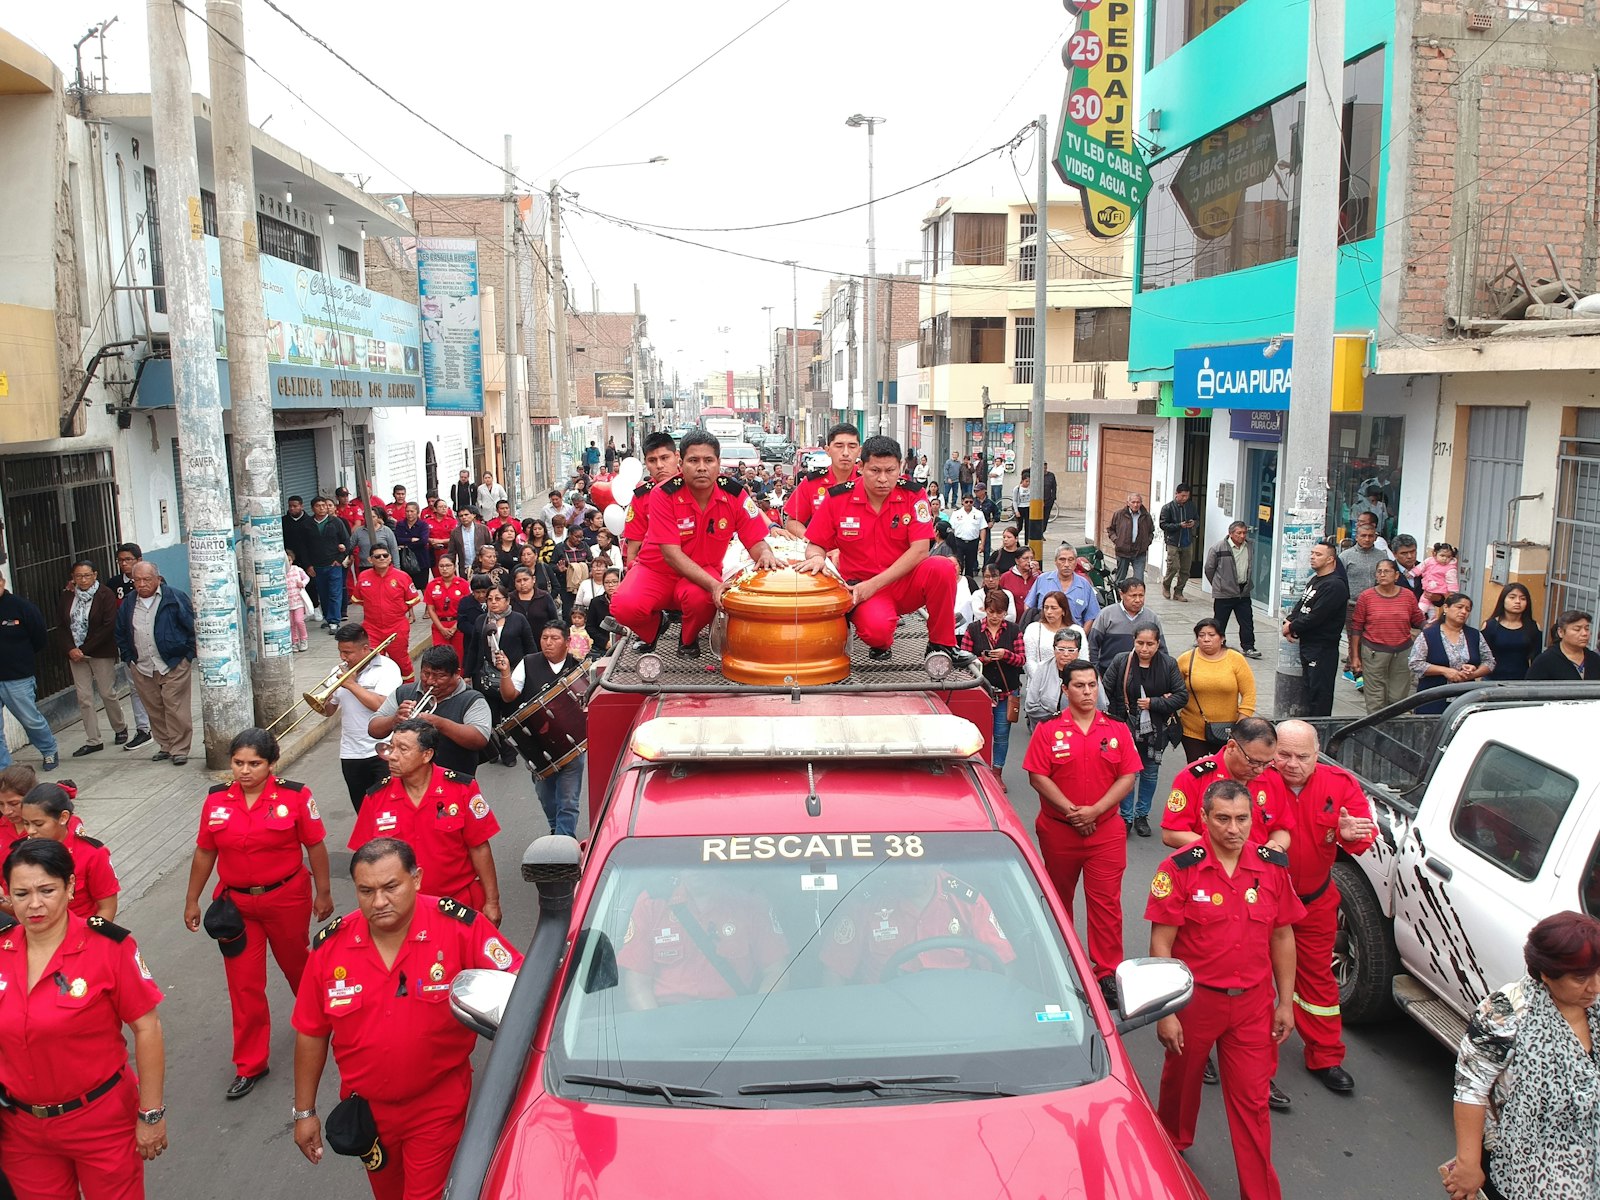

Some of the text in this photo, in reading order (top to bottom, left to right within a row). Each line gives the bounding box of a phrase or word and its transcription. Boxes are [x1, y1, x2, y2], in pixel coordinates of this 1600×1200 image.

[1071, 36, 1100, 61] 25
[1070, 95, 1101, 120] 30
[1066, 131, 1143, 182] TV LED CABLE
[1065, 155, 1140, 203] VIDEO AGUA C.
[369, 381, 382, 398] LOS
[1216, 368, 1292, 394] CAJA PIURA
[1251, 411, 1271, 421] CAJERO
[1251, 420, 1266, 430] PIURA
[1433, 442, 1451, 457] 217-1
[190, 540, 225, 550] CUARTO
[702, 834, 924, 862] RESCATE 38
